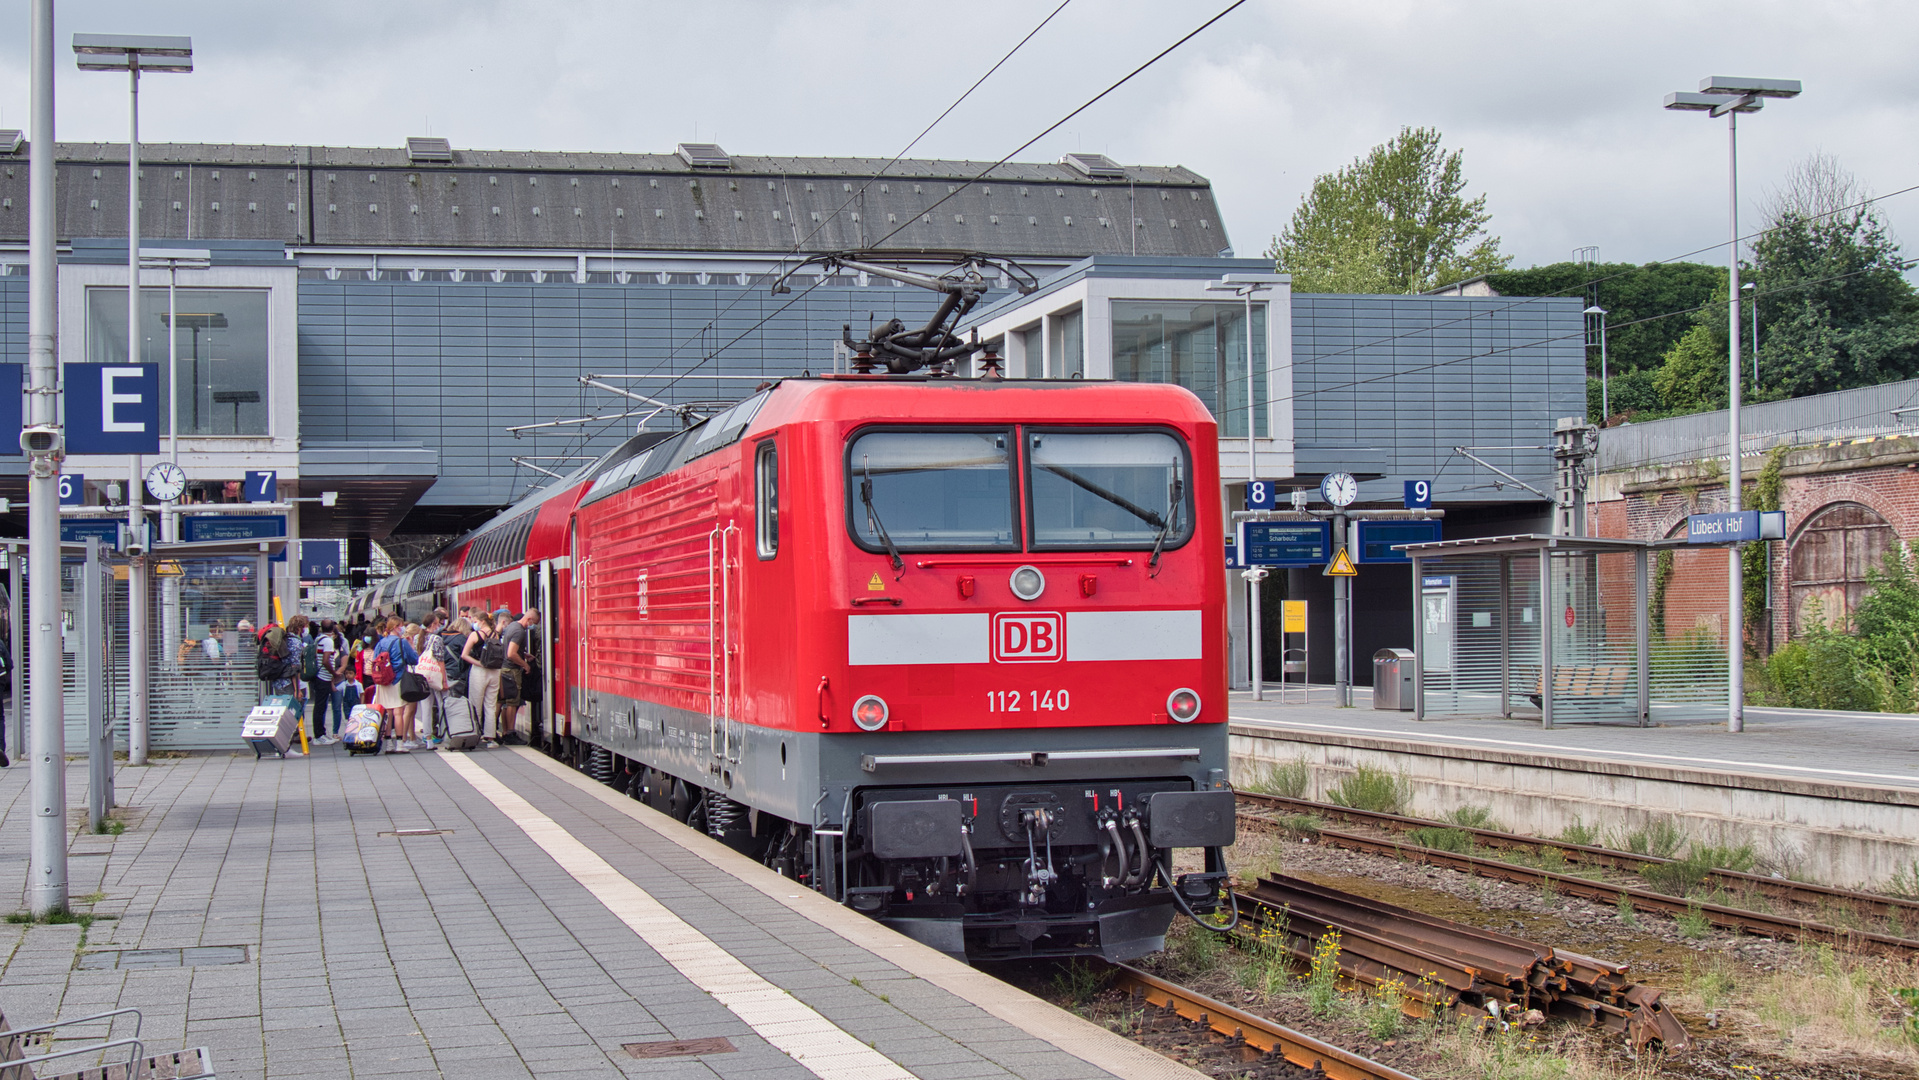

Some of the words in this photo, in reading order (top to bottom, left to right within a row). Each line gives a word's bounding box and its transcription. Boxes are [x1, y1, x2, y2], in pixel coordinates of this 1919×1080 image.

[101, 367, 145, 432] E
[59, 475, 72, 498] 6
[257, 472, 273, 494] 7
[1252, 482, 1266, 503] 8
[1415, 481, 1428, 503] 9
[1691, 518, 1723, 535] Lübeck
[1726, 517, 1743, 532] Hbf
[1004, 621, 1054, 654] DB
[420, 656, 436, 664] Hau
[987, 690, 1021, 712] 112
[1030, 689, 1070, 711] 140
[962, 794, 974, 802] HLL
